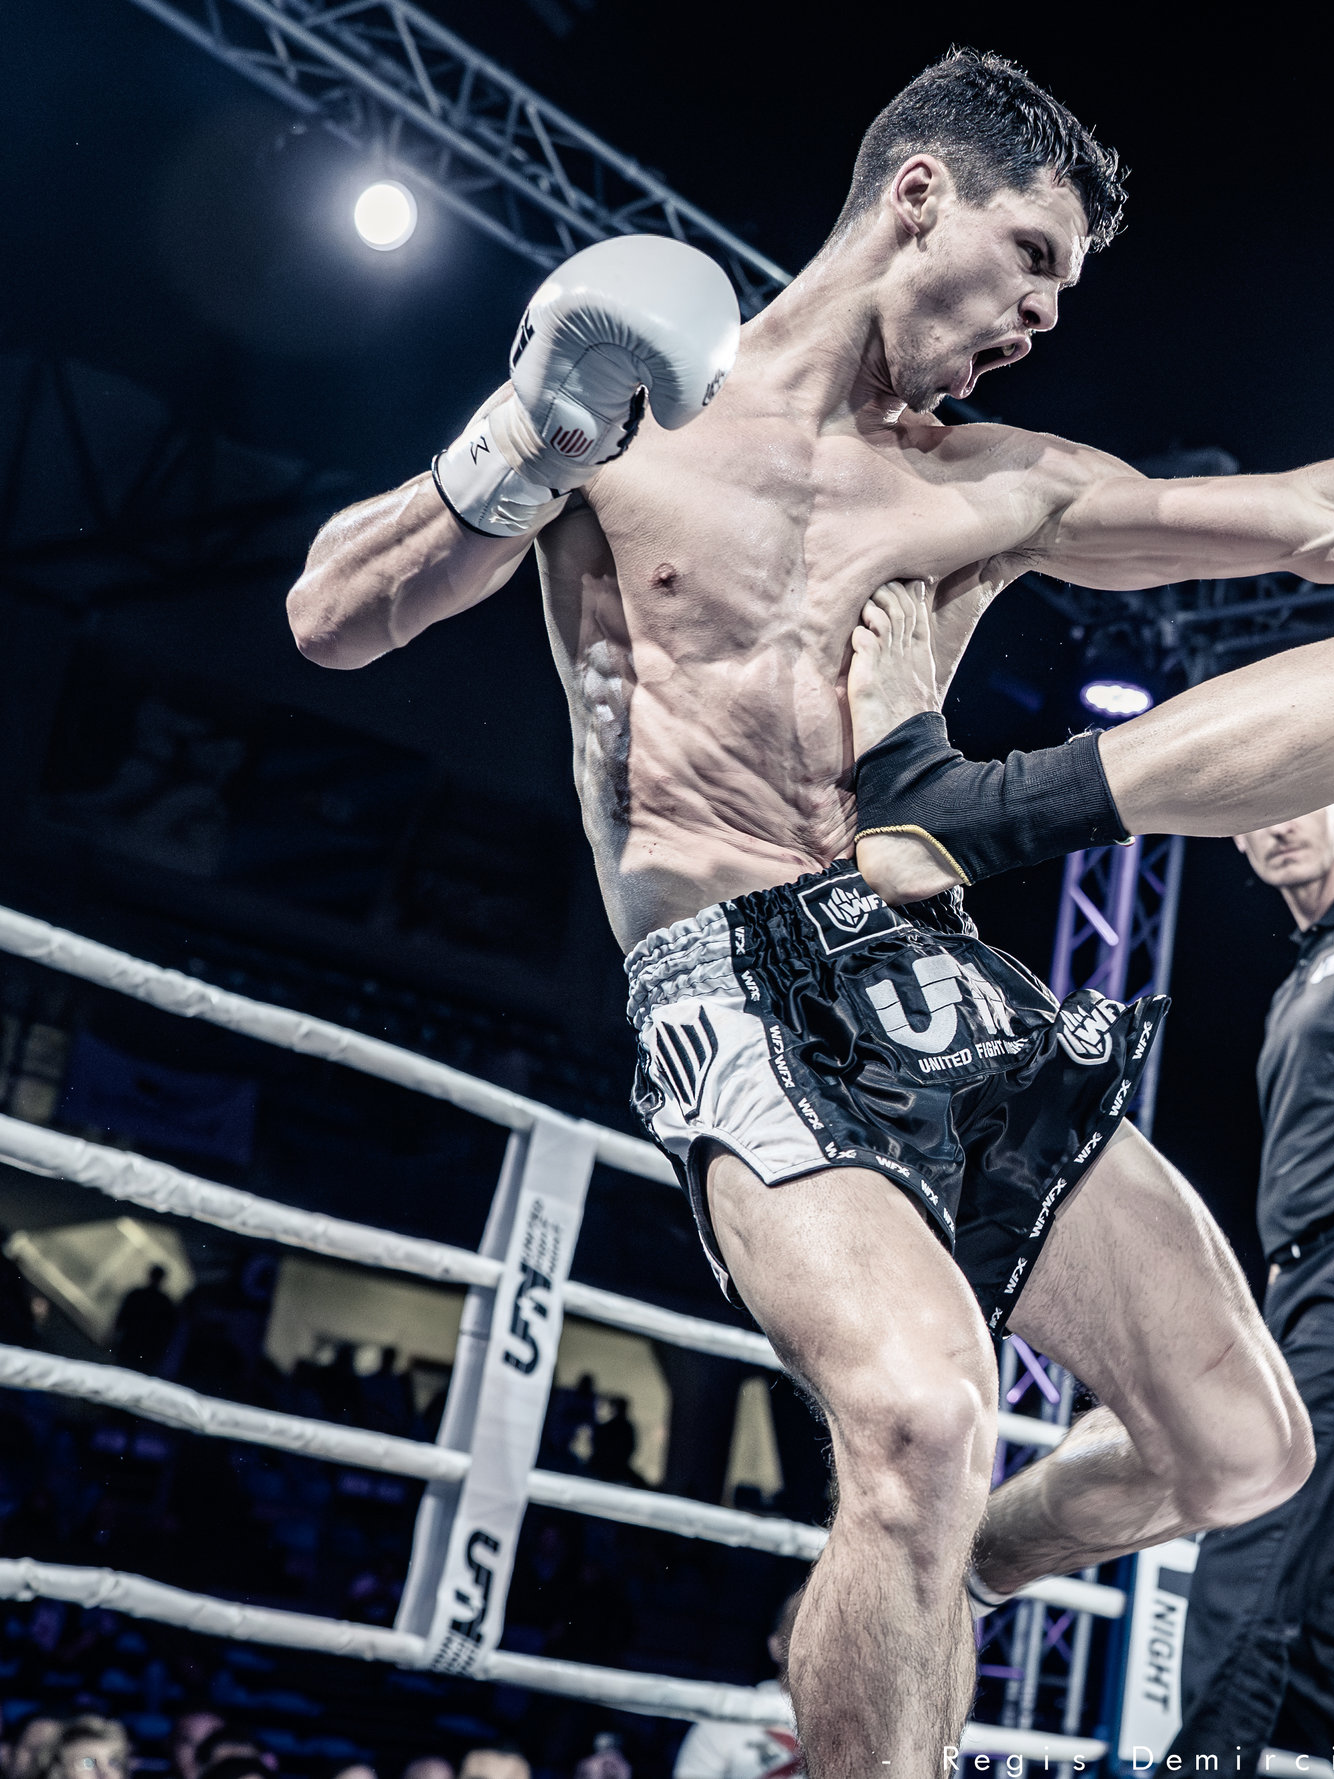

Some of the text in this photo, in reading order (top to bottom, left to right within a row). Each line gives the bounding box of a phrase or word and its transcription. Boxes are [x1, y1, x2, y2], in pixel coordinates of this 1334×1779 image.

[917, 1047, 973, 1074] UNITED
[975, 1038, 1006, 1059] FIGHT
[1131, 1021, 1153, 1061] WFX
[774, 1055, 796, 1089] WFX
[796, 1097, 825, 1131] WFX
[1108, 1078, 1132, 1117] WFX
[1073, 1131, 1103, 1165] WFX
[875, 1155, 911, 1178] WFX
[920, 1179, 940, 1207] WFX
[1003, 1256, 1028, 1295] WFX
[1144, 1598, 1178, 1714] NIGHT
